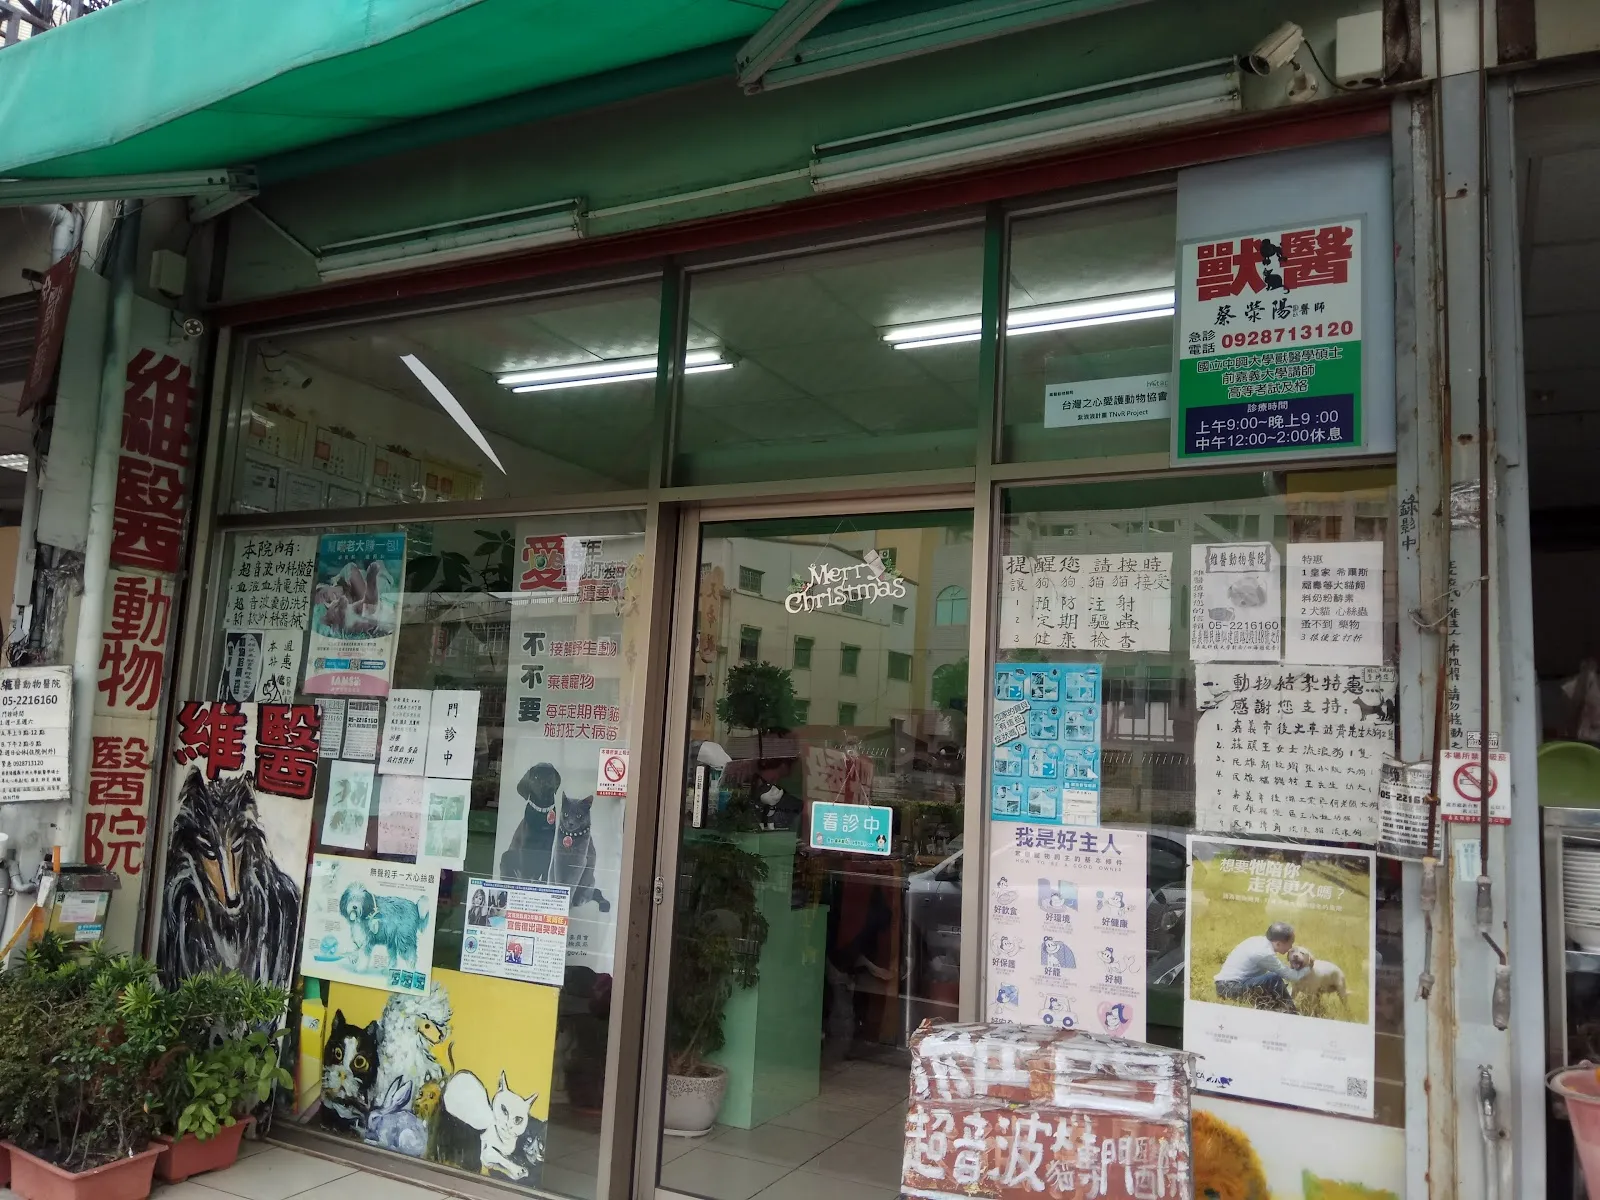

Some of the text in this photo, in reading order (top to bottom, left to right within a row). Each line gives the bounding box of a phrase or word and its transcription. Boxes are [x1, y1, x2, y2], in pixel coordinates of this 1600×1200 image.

[1196, 225, 1354, 301] 獸醫
[1188, 329, 1216, 343] 急診
[1221, 320, 1354, 349] 0928713120
[1188, 343, 1216, 355] 電話
[1197, 347, 1343, 373] 國立中興大學獸醫學碩士
[1222, 364, 1315, 385] 前嘉義大學講師
[1228, 380, 1308, 399] 高等考試及格
[1126, 409, 1149, 417] Project
[1247, 401, 1289, 414] 診療時間
[520, 534, 567, 590] 愛
[1302, 555, 1323, 564] 特惠
[1310, 568, 1330, 577] 皇家
[785, 577, 906, 614] Christmas
[1035, 594, 1135, 612] 預防注射
[1310, 607, 1330, 616] 犬貓
[1336, 607, 1368, 617] 心絲蟲
[1208, 621, 1279, 631] 05-2216160
[1339, 620, 1360, 629] 藥物
[550, 641, 617, 657] 接觸野生動物
[547, 674, 594, 690] 棄養寵物
[2, 695, 58, 706] 05-2216160
[444, 702, 459, 766] 門診中
[173, 701, 321, 800] 維醫
[1445, 752, 1506, 761] 本場所禁吸菸
[823, 812, 879, 834] 看診中
[1015, 827, 1121, 855] 我是好主人
[994, 905, 1017, 916] 好飲食
[1045, 913, 1071, 924] 好環境
[1102, 917, 1128, 928] 好健康
